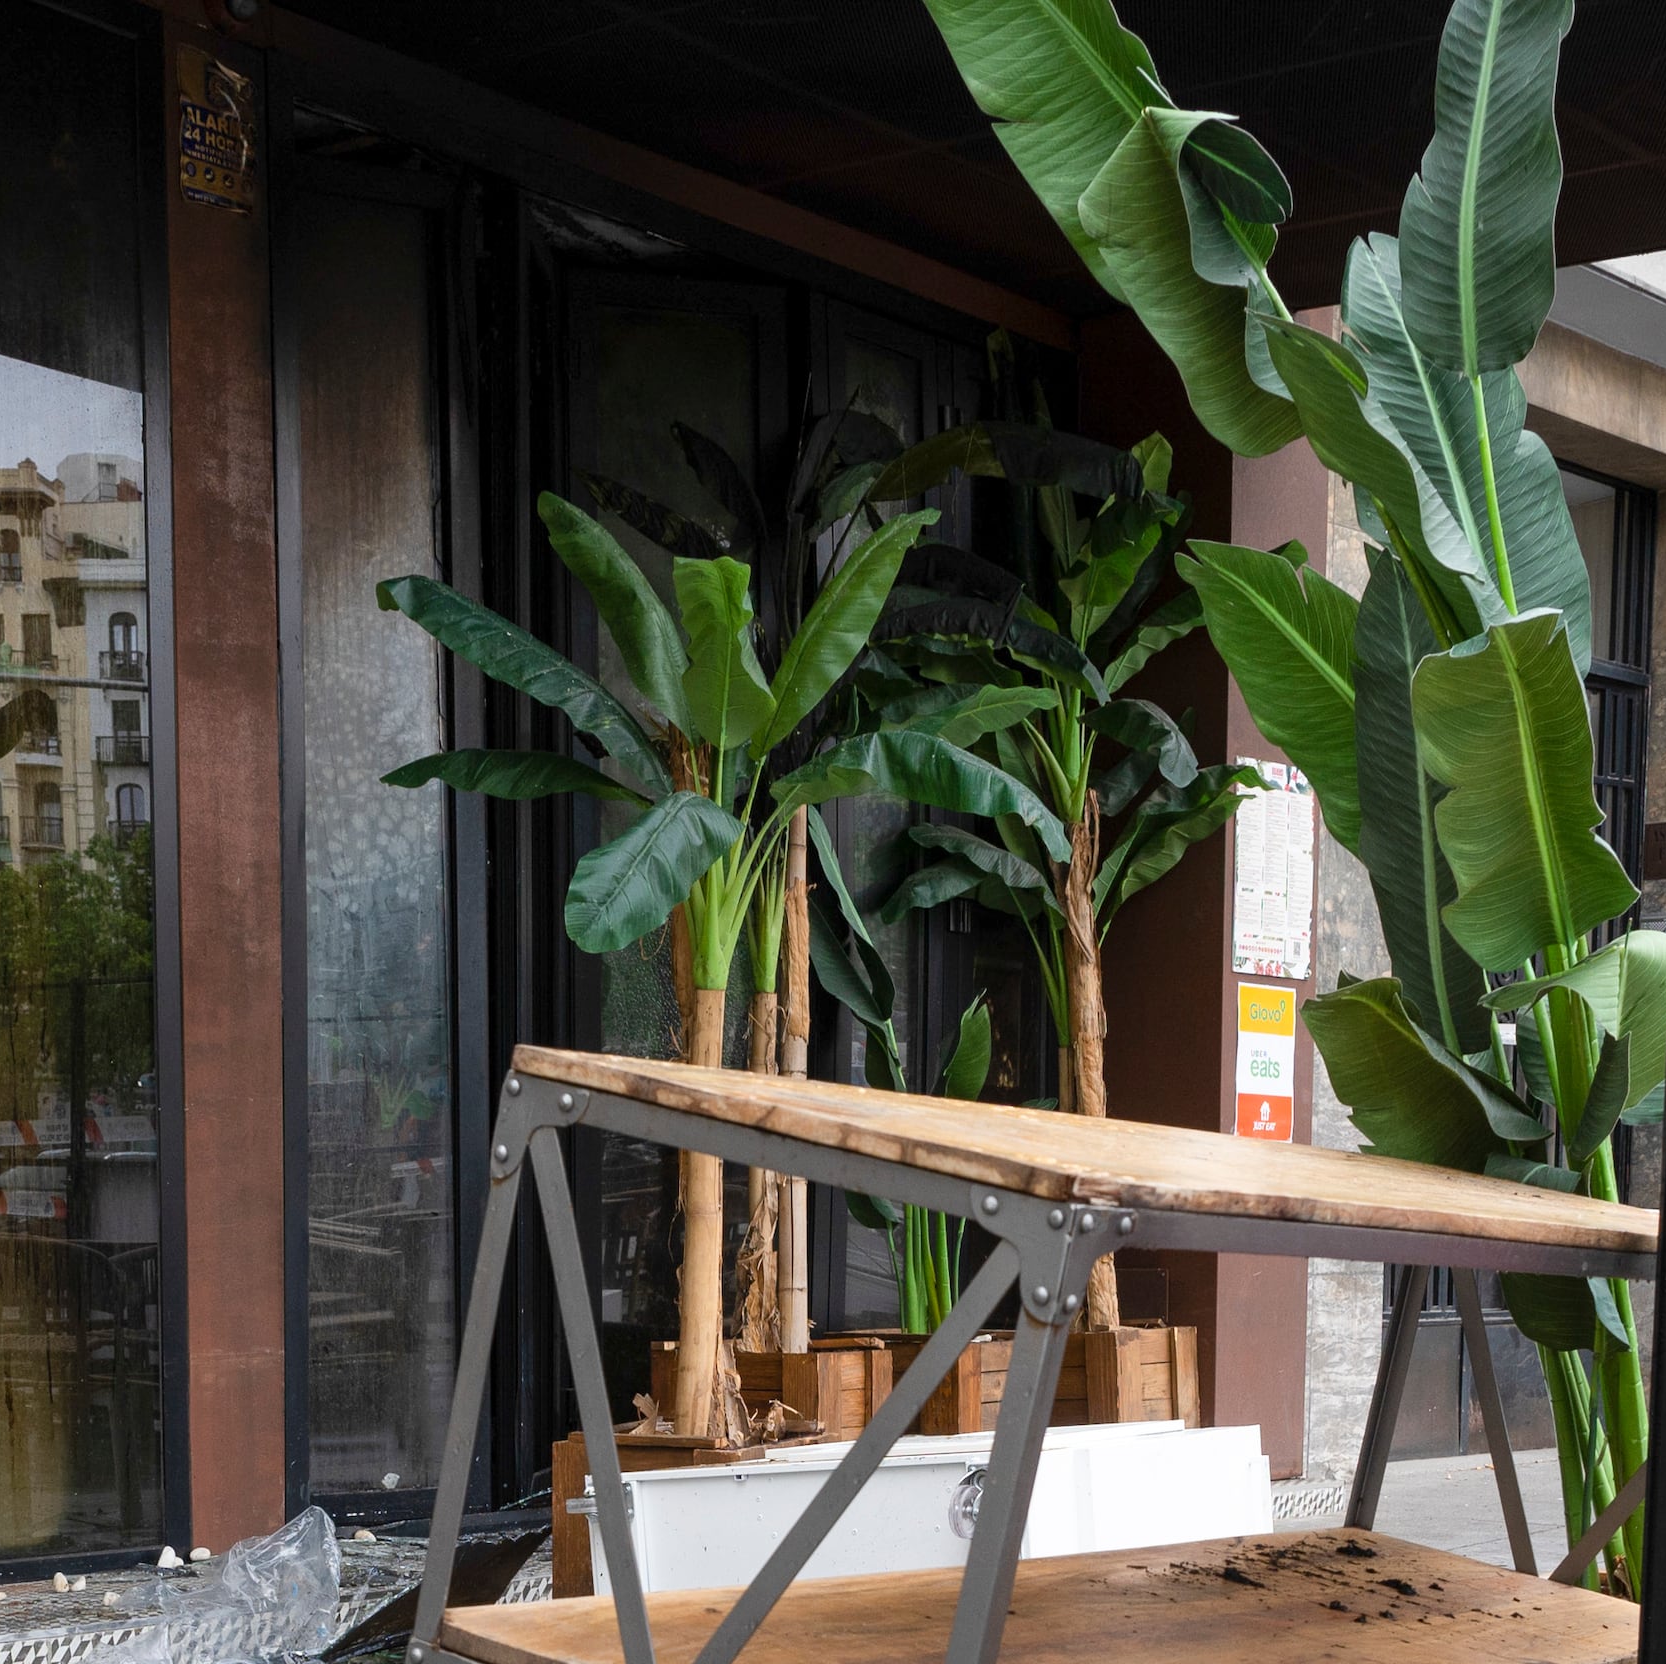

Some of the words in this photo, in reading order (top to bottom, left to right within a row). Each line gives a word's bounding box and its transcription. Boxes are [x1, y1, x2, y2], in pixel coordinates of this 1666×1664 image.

[184, 126, 201, 142] 24
[1250, 1002, 1283, 1022] Glovo
[1250, 1057, 1281, 1079] eats
[1253, 1121, 1265, 1131] JUST
[1265, 1122, 1276, 1132] EAT
